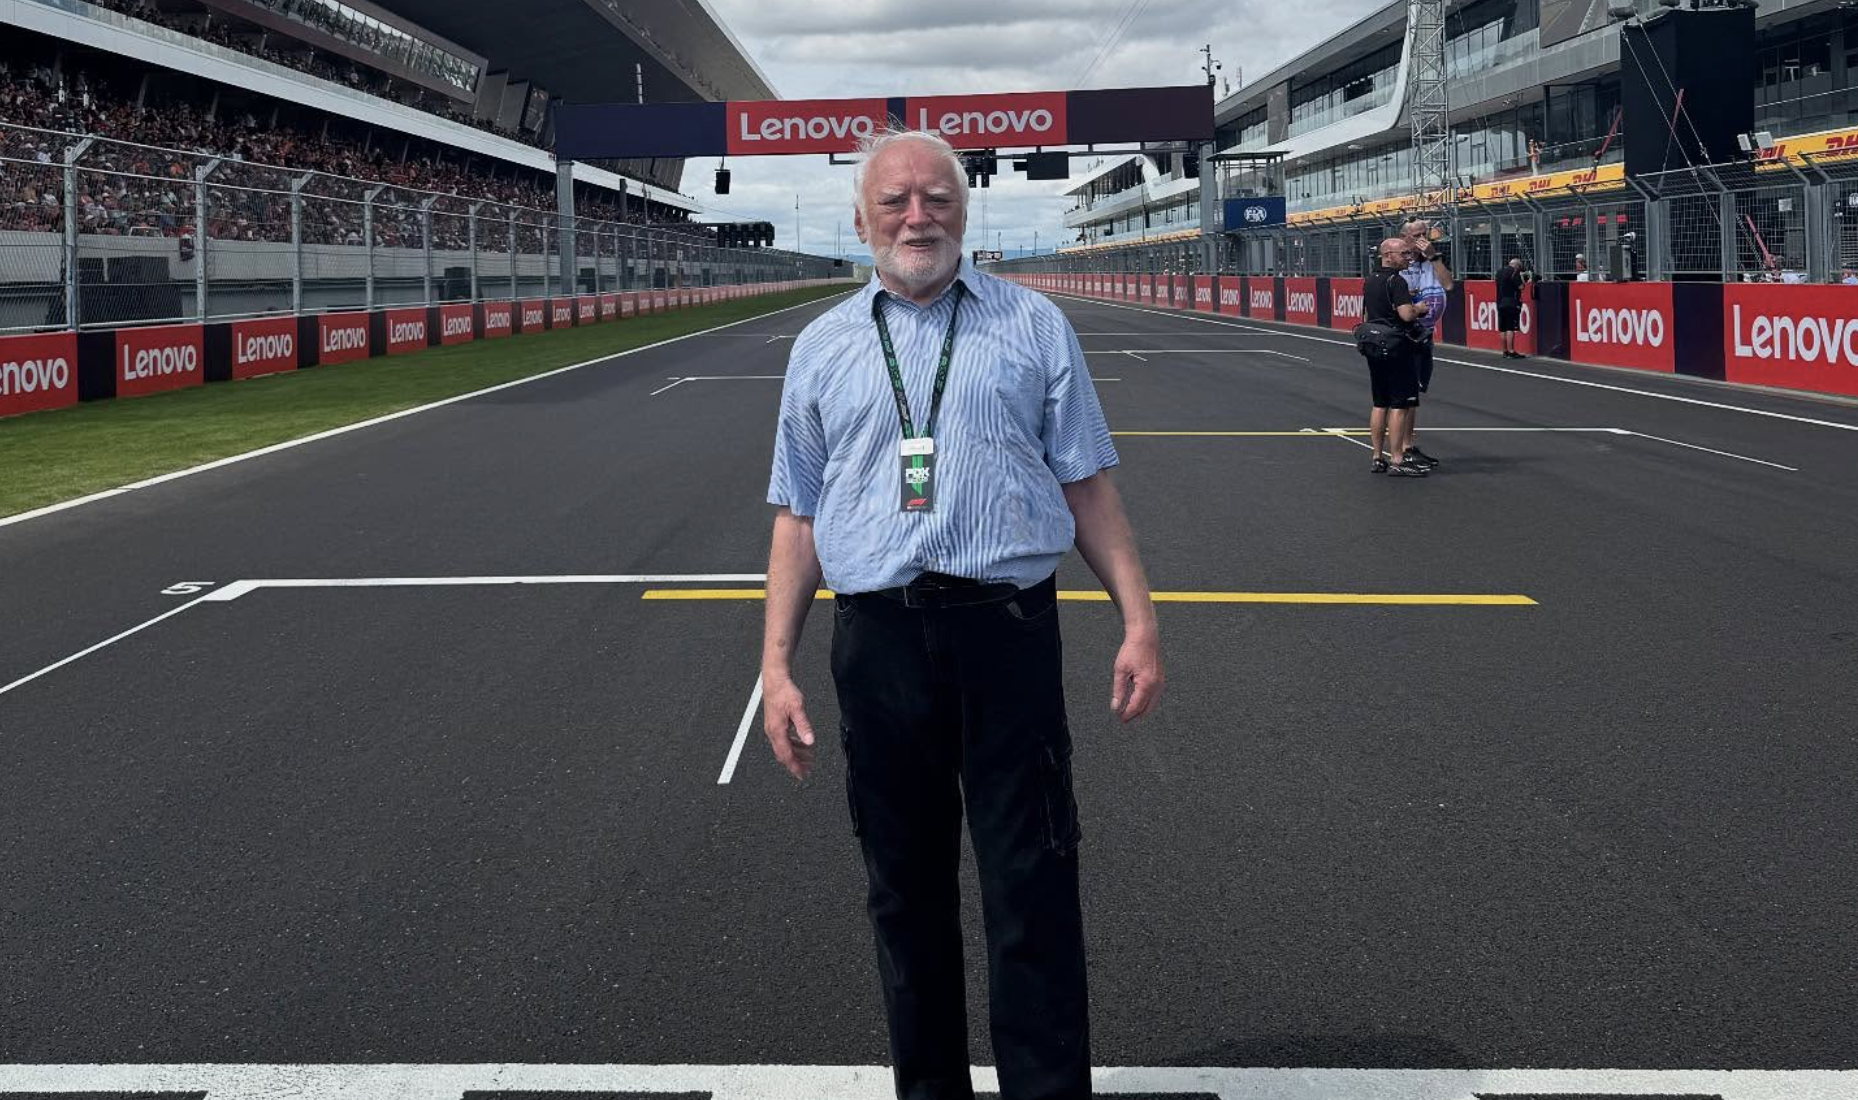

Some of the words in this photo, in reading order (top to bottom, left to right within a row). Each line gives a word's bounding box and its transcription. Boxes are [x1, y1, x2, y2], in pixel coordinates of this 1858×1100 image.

[741, 112, 873, 141] Lenovo
[919, 108, 1053, 136] Lenovo
[1286, 286, 1315, 313] Lenovo
[1333, 288, 1364, 318] Lenov
[1470, 294, 1530, 334] Leno
[390, 319, 425, 344] Lenovo
[443, 313, 471, 337] Lenovo
[485, 309, 510, 329] Lenovo
[1576, 299, 1664, 347] Lenovo
[238, 332, 293, 364] Lenovo
[323, 325, 366, 353] Lenovo
[1733, 304, 1858, 367] Lenovo
[0, 357, 69, 396] novo
[123, 344, 197, 381] Lenovo
[160, 581, 215, 595] 5
